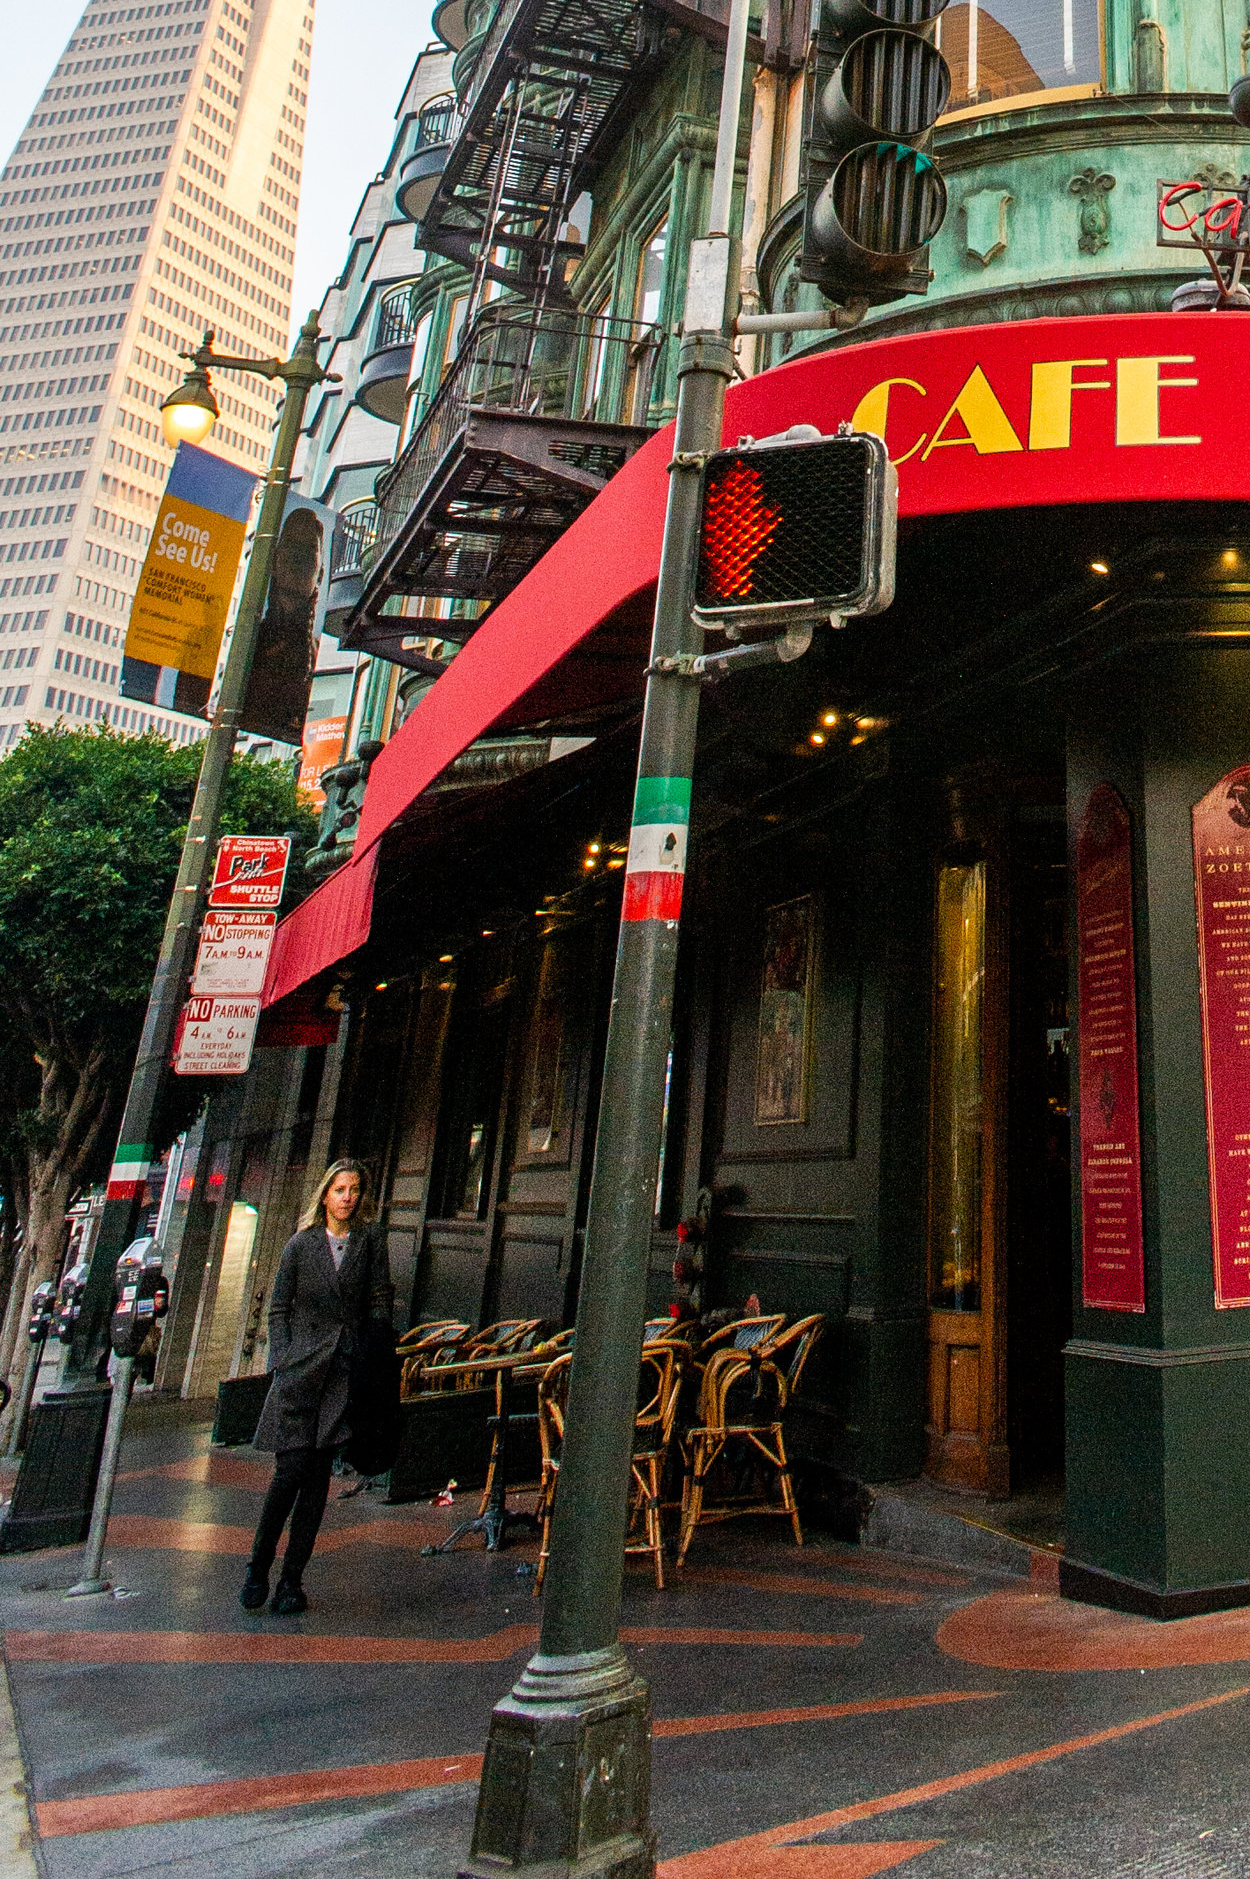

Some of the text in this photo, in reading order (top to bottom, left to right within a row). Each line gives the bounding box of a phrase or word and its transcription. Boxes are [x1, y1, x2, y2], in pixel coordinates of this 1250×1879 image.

[850, 355, 1202, 465] CAFE
[162, 512, 210, 547] Come
[155, 534, 218, 573] See Us!
[165, 570, 206, 593] FRANCISCO
[316, 731, 345, 741] Mathe
[229, 852, 270, 876] Park
[230, 885, 280, 894] SHUTTLE
[249, 894, 279, 902] STOP
[214, 913, 268, 924] TOW-AWAY
[204, 924, 270, 941] NO STOPPING
[189, 999, 257, 1019] NO PARKING
[200, 1042, 232, 1050] EVERYDAY
[183, 1051, 246, 1059] INCLUDING HOLIDAYS
[184, 1062, 241, 1070] STREET CLEANING
